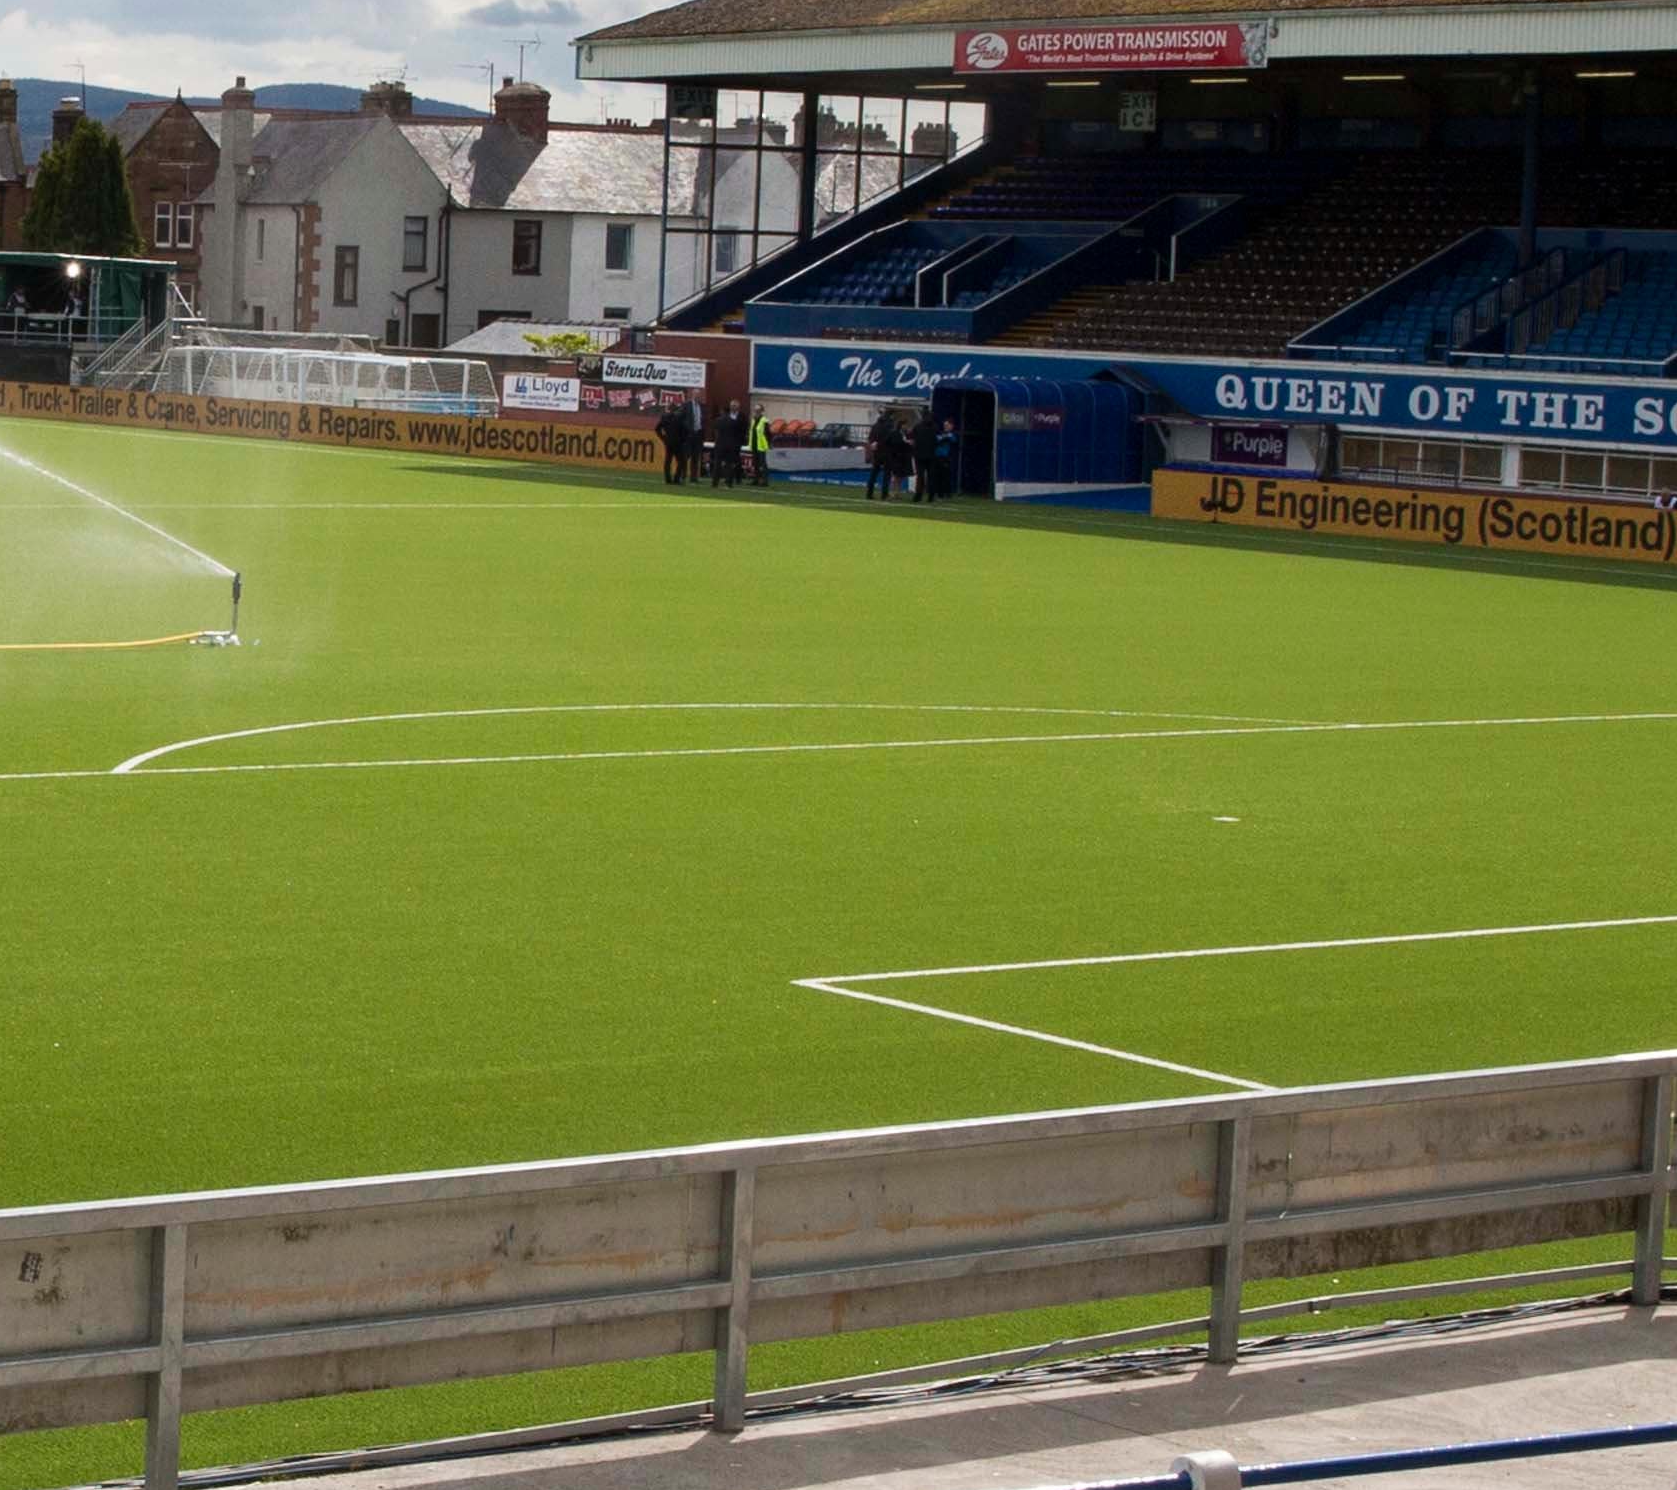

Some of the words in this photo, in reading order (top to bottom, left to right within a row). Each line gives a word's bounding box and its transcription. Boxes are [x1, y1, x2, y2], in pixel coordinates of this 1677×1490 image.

[1017, 33, 1061, 52] GATES
[1063, 32, 1115, 51] POWER
[1117, 30, 1227, 50] TRANSMISSION
[1119, 92, 1157, 109] EXIT
[1132, 110, 1144, 126] C
[840, 356, 883, 388] The
[532, 378, 570, 398] Lloyd
[1215, 374, 1386, 417] QUEEN
[1408, 384, 1475, 422] OF
[1497, 389, 1605, 432] THE
[18, 383, 122, 417] Truck-Trailer
[127, 395, 139, 419] &
[205, 398, 290, 438] Servicing
[298, 406, 312, 434] &
[318, 407, 400, 445] Repairs.
[407, 417, 655, 462] www.jdescotland.com
[1232, 431, 1284, 458] Purple
[1199, 476, 1245, 513] JD
[1256, 480, 1465, 543] Engineering
[1478, 498, 1676, 561] (Scotland)
